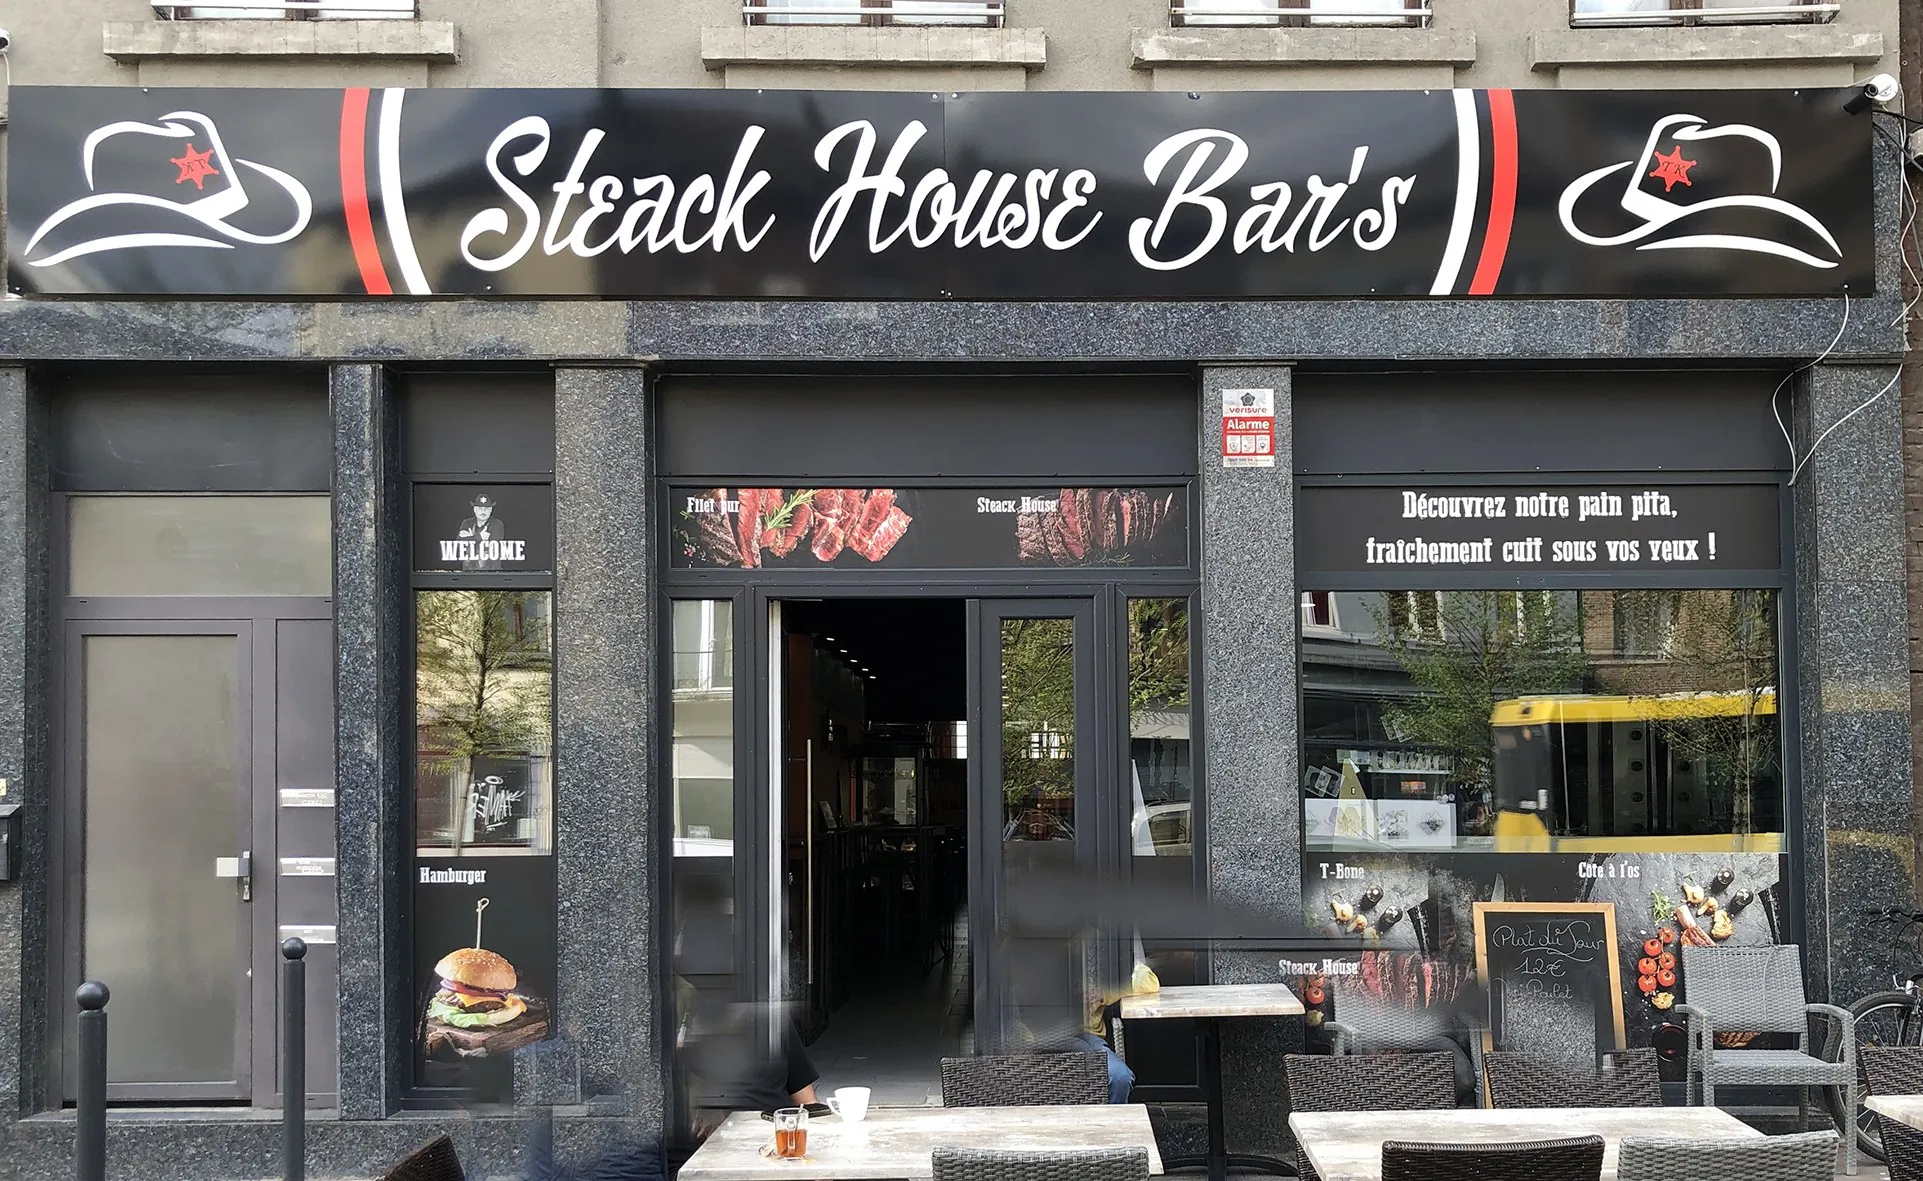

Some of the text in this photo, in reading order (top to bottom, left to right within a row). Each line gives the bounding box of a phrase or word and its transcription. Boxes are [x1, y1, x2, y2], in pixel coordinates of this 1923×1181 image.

[461, 115, 1417, 271] Steack House Bar's
[1227, 419, 1270, 430] Alarme
[687, 496, 740, 515] Filet pur
[977, 496, 1058, 513] Steack House
[1402, 491, 1678, 521] Découvrez notre pain pita,
[440, 540, 525, 561] WELCOME
[1366, 537, 1493, 564] fraîchement
[1502, 537, 1543, 562] cuit
[1552, 540, 1597, 562] sous
[1605, 540, 1640, 562] vos
[1648, 540, 1699, 562] yeux
[420, 867, 487, 885] Hamburger
[1319, 863, 1365, 879] T-Bone
[1608, 863, 1616, 878] à
[1620, 860, 1640, 878] l'os
[1492, 925, 1535, 948] Plat
[1538, 921, 1563, 946] du
[1279, 959, 1358, 976] Steack House
[1514, 957, 1566, 977] 12€
